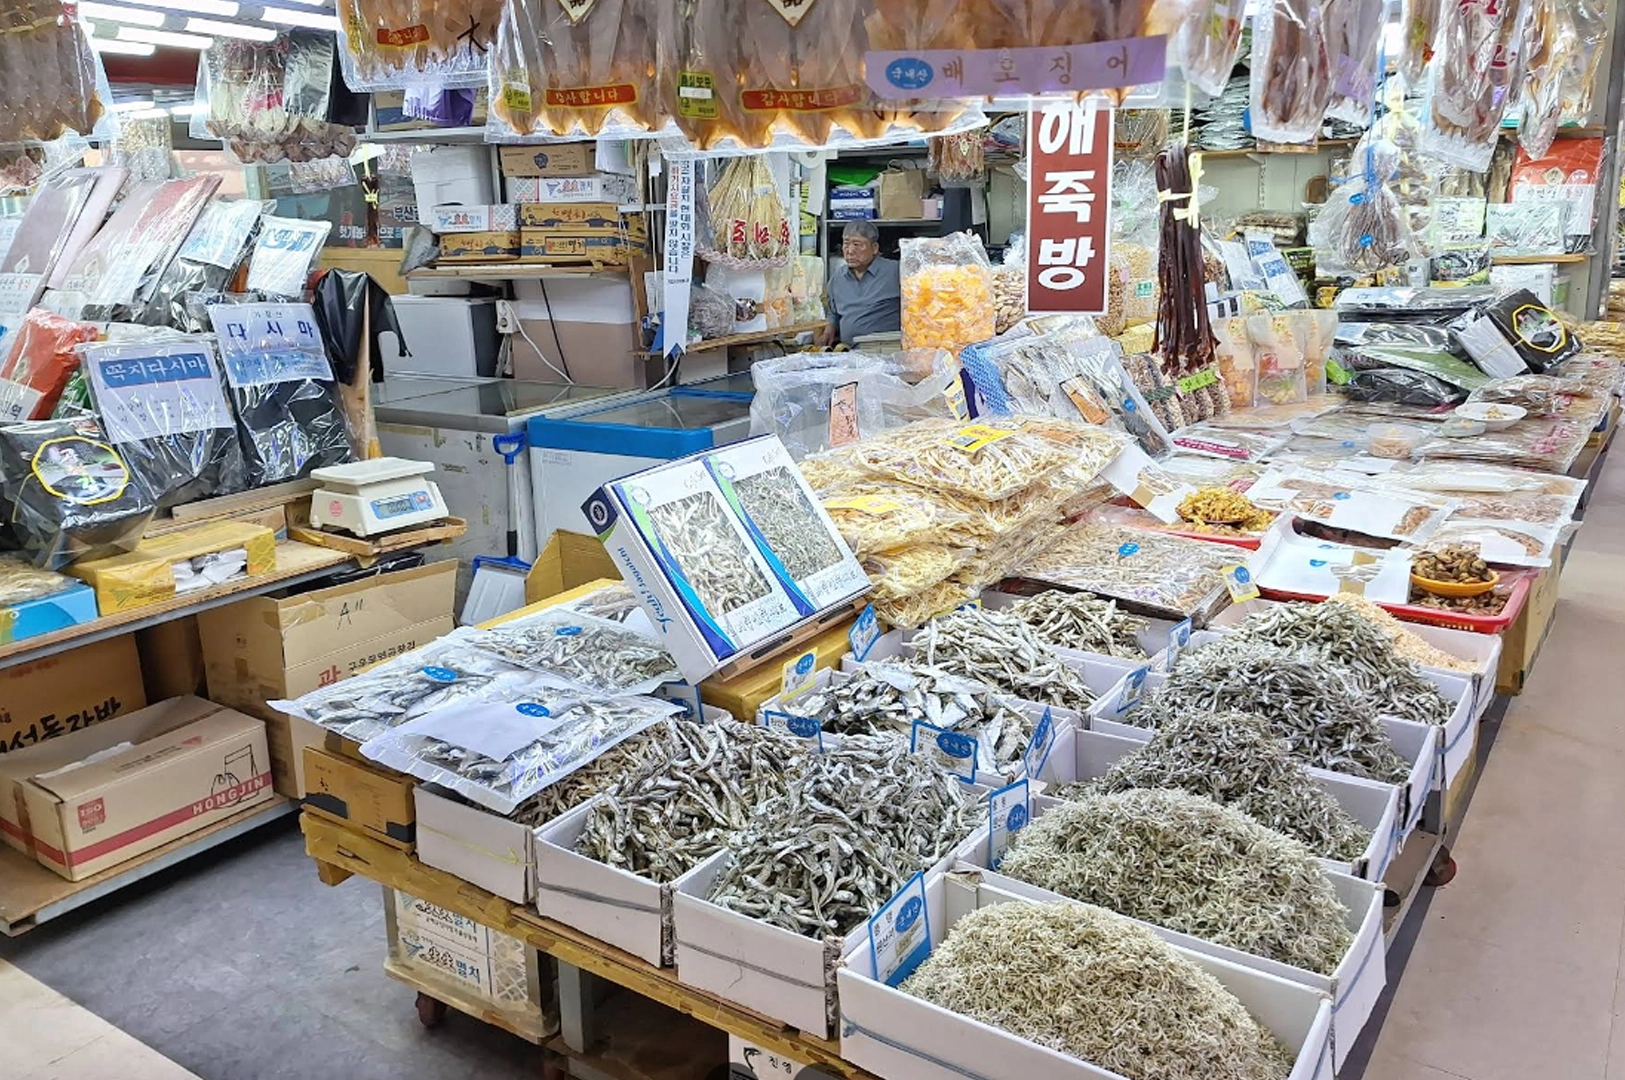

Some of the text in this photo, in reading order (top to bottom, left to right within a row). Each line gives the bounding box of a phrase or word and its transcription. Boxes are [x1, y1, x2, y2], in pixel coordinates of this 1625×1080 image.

[890, 66, 929, 84] 국내산
[760, 90, 839, 107] 감사합니다
[226, 320, 314, 341] 다시마
[191, 777, 265, 816] HONGJIN
[80, 803, 103, 817] ISO
